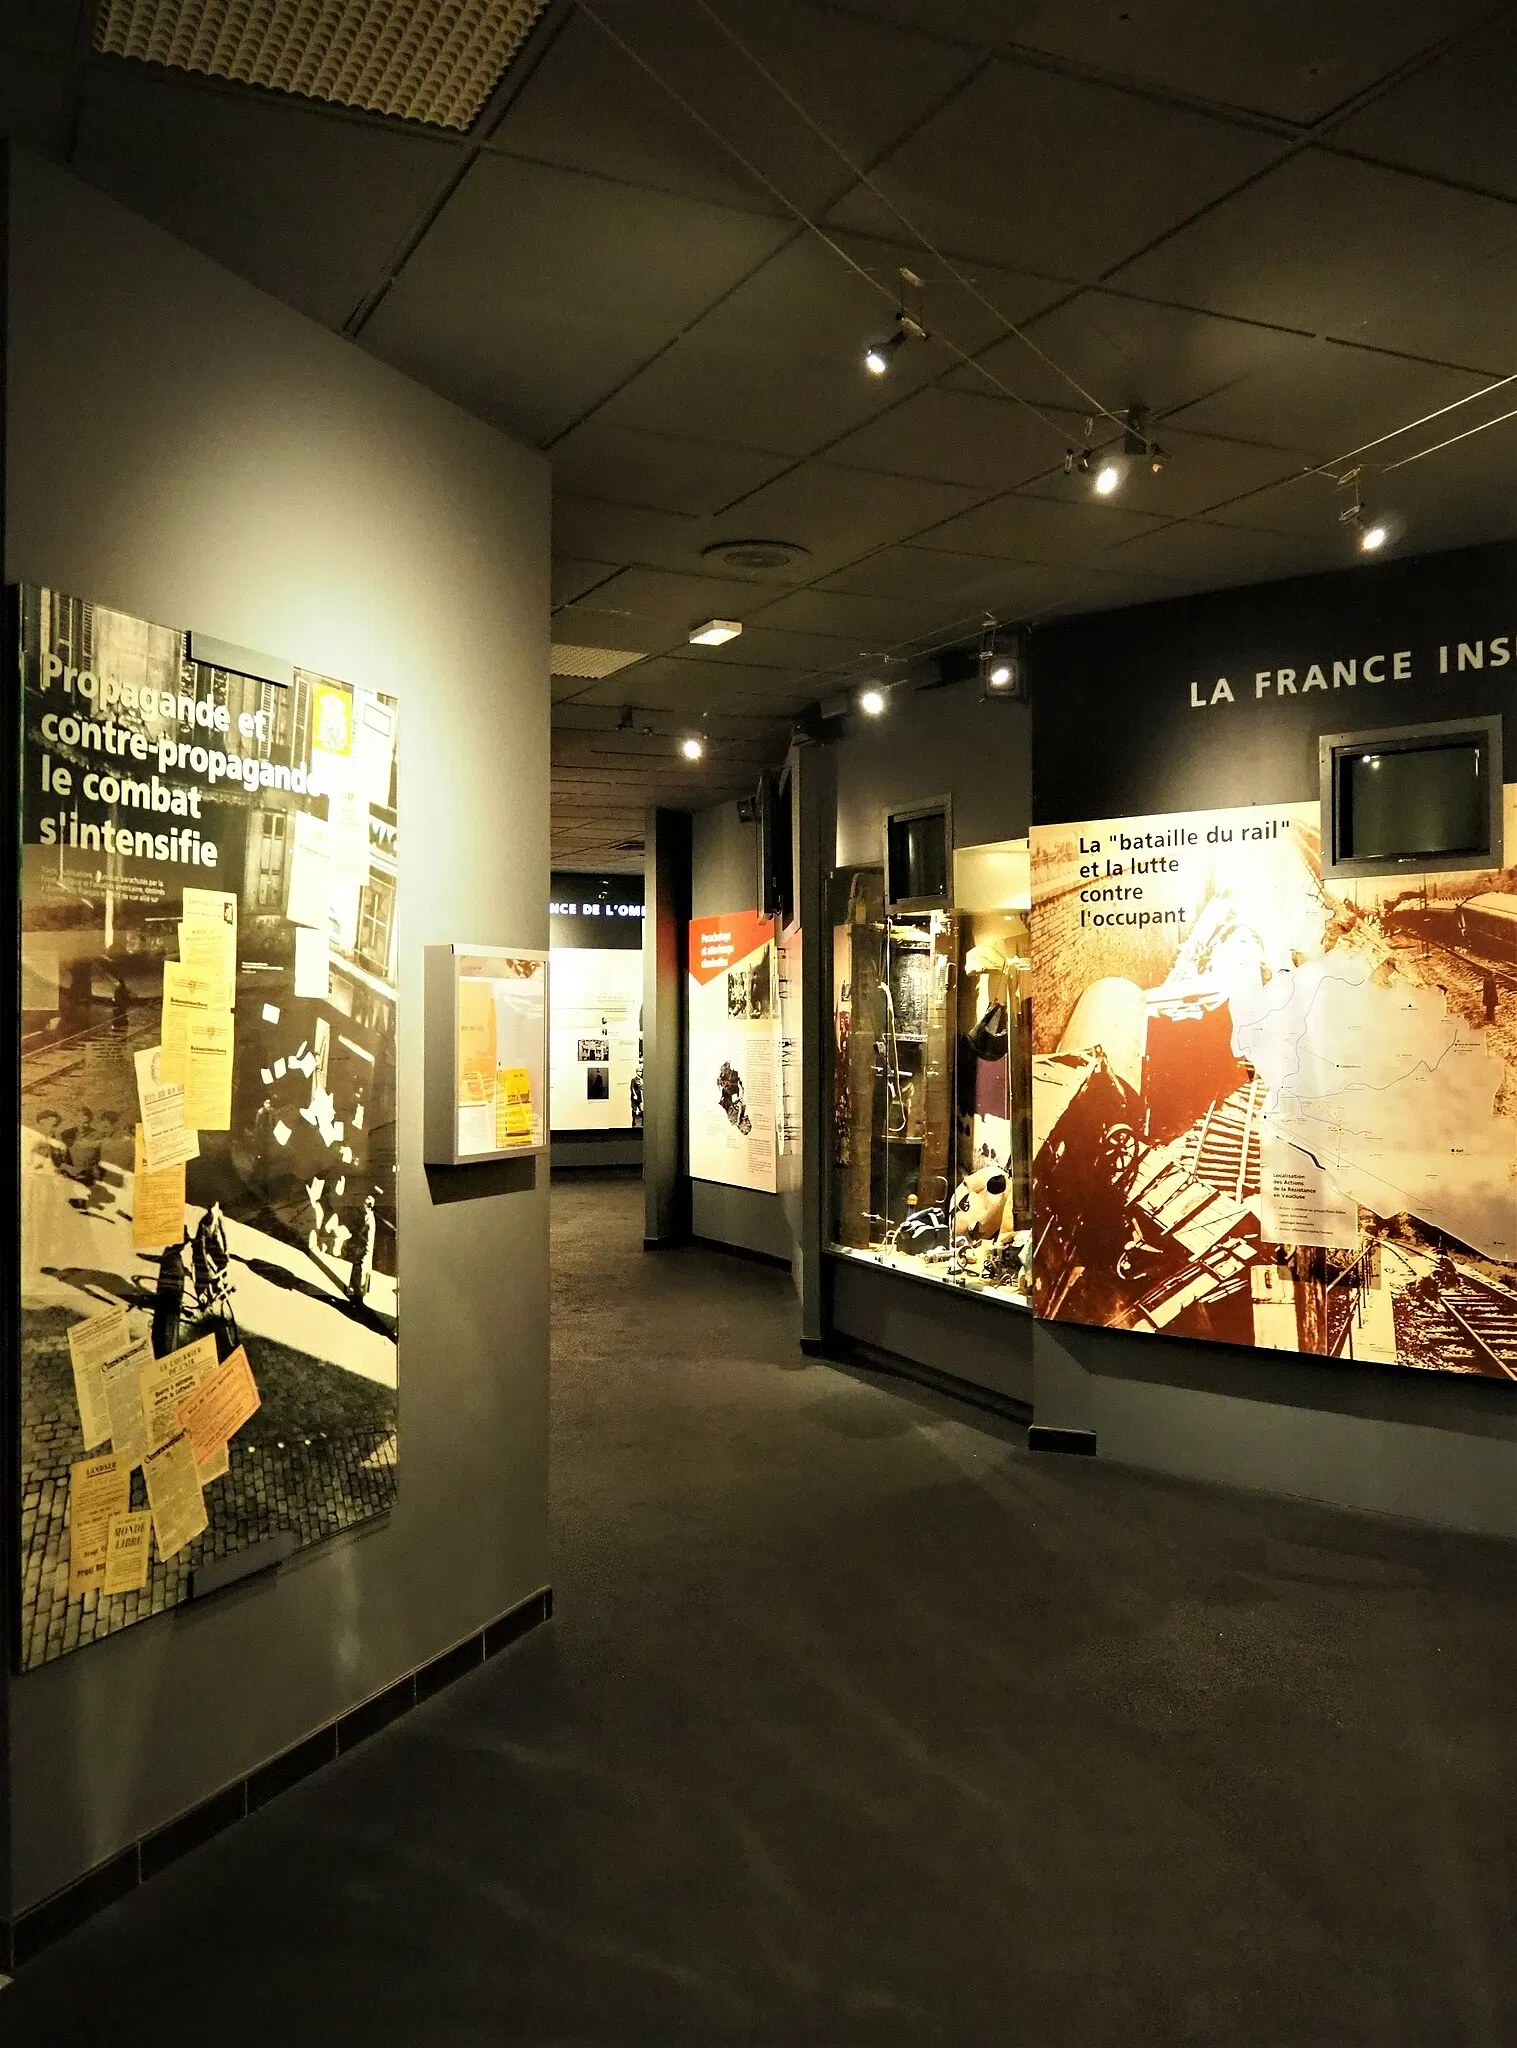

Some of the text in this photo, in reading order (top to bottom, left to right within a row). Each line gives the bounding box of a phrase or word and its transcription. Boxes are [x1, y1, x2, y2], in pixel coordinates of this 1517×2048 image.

[1191, 637, 1517, 707] LA FRANCE INS
[44, 652, 267, 742] Propagande et
[41, 755, 202, 819] le combat
[40, 811, 218, 867] s'intensifie
[1080, 820, 1290, 853] La "bataille du rail"
[1079, 856, 1179, 878] et la lutte
[583, 903, 600, 916] DE
[1080, 885, 1143, 902] contre
[1080, 907, 1186, 929] l'occupant
